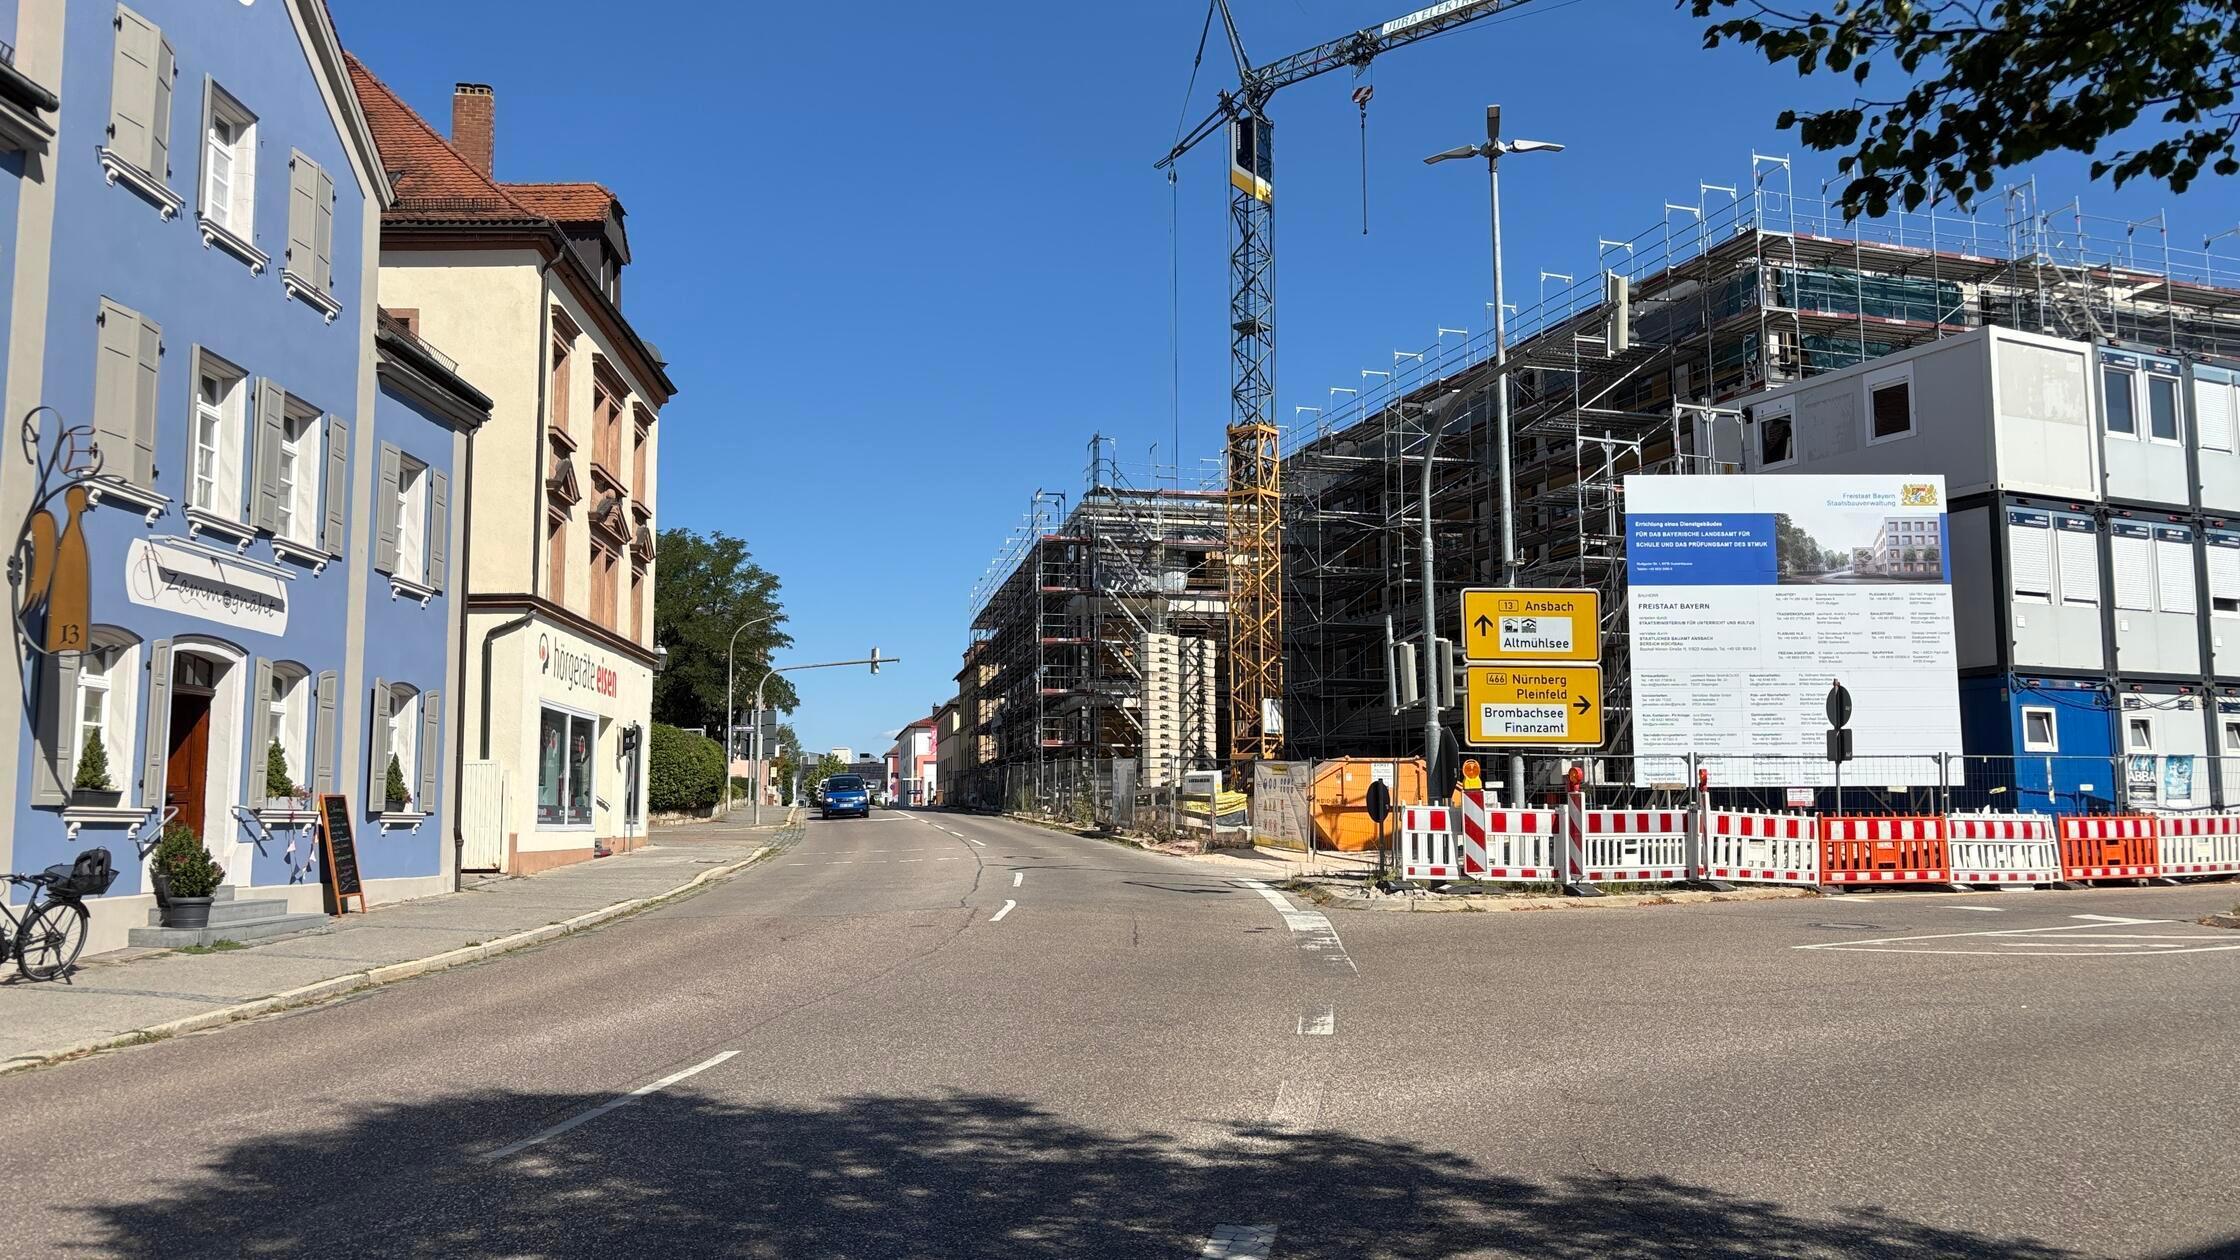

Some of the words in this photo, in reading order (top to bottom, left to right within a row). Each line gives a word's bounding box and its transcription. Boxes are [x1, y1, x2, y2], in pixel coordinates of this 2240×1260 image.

[1384, 14, 1418, 33] JURA
[1504, 601, 1513, 609] 13
[1525, 601, 1574, 611] Ansbach
[60, 623, 80, 645] 13
[1503, 637, 1569, 649] Altmühlsee
[554, 636, 595, 692] hörgeräte
[596, 657, 617, 698] eisen
[1488, 674, 1505, 683] 466
[1512, 673, 1567, 687] Nürnberg
[1516, 689, 1567, 699] Pleinfeld
[1484, 707, 1564, 718] Brombachsee
[1505, 722, 1565, 733] Finanzamt
[2127, 770, 2157, 782] ABBA
